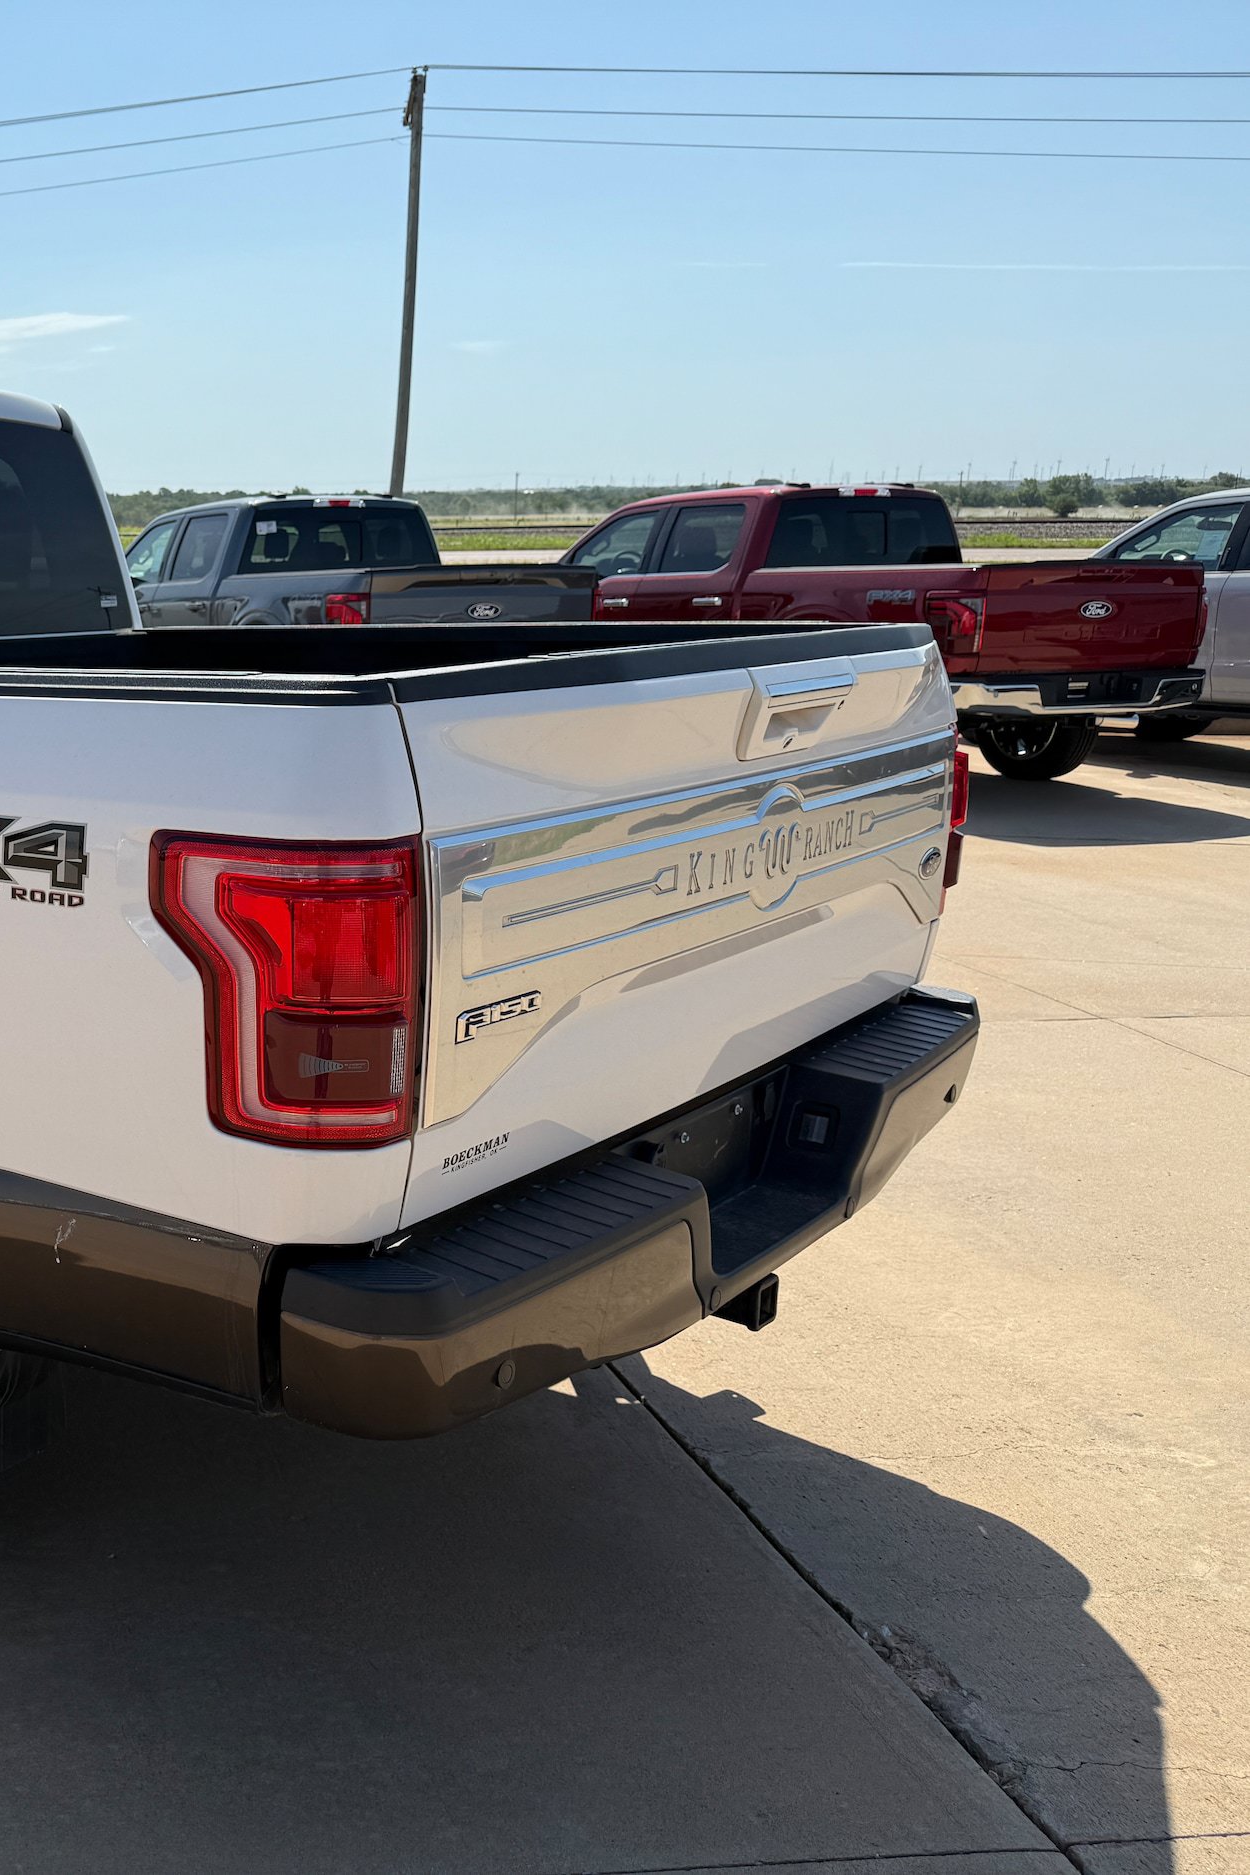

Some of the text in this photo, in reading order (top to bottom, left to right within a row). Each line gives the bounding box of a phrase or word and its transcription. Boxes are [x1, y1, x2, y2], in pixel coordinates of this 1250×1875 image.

[471, 604, 498, 618] Ford
[1084, 602, 1109, 616] Ford
[686, 810, 855, 896] KING RANCH
[11, 885, 86, 908] ROAD
[441, 1132, 511, 1170] BOECKMAN
